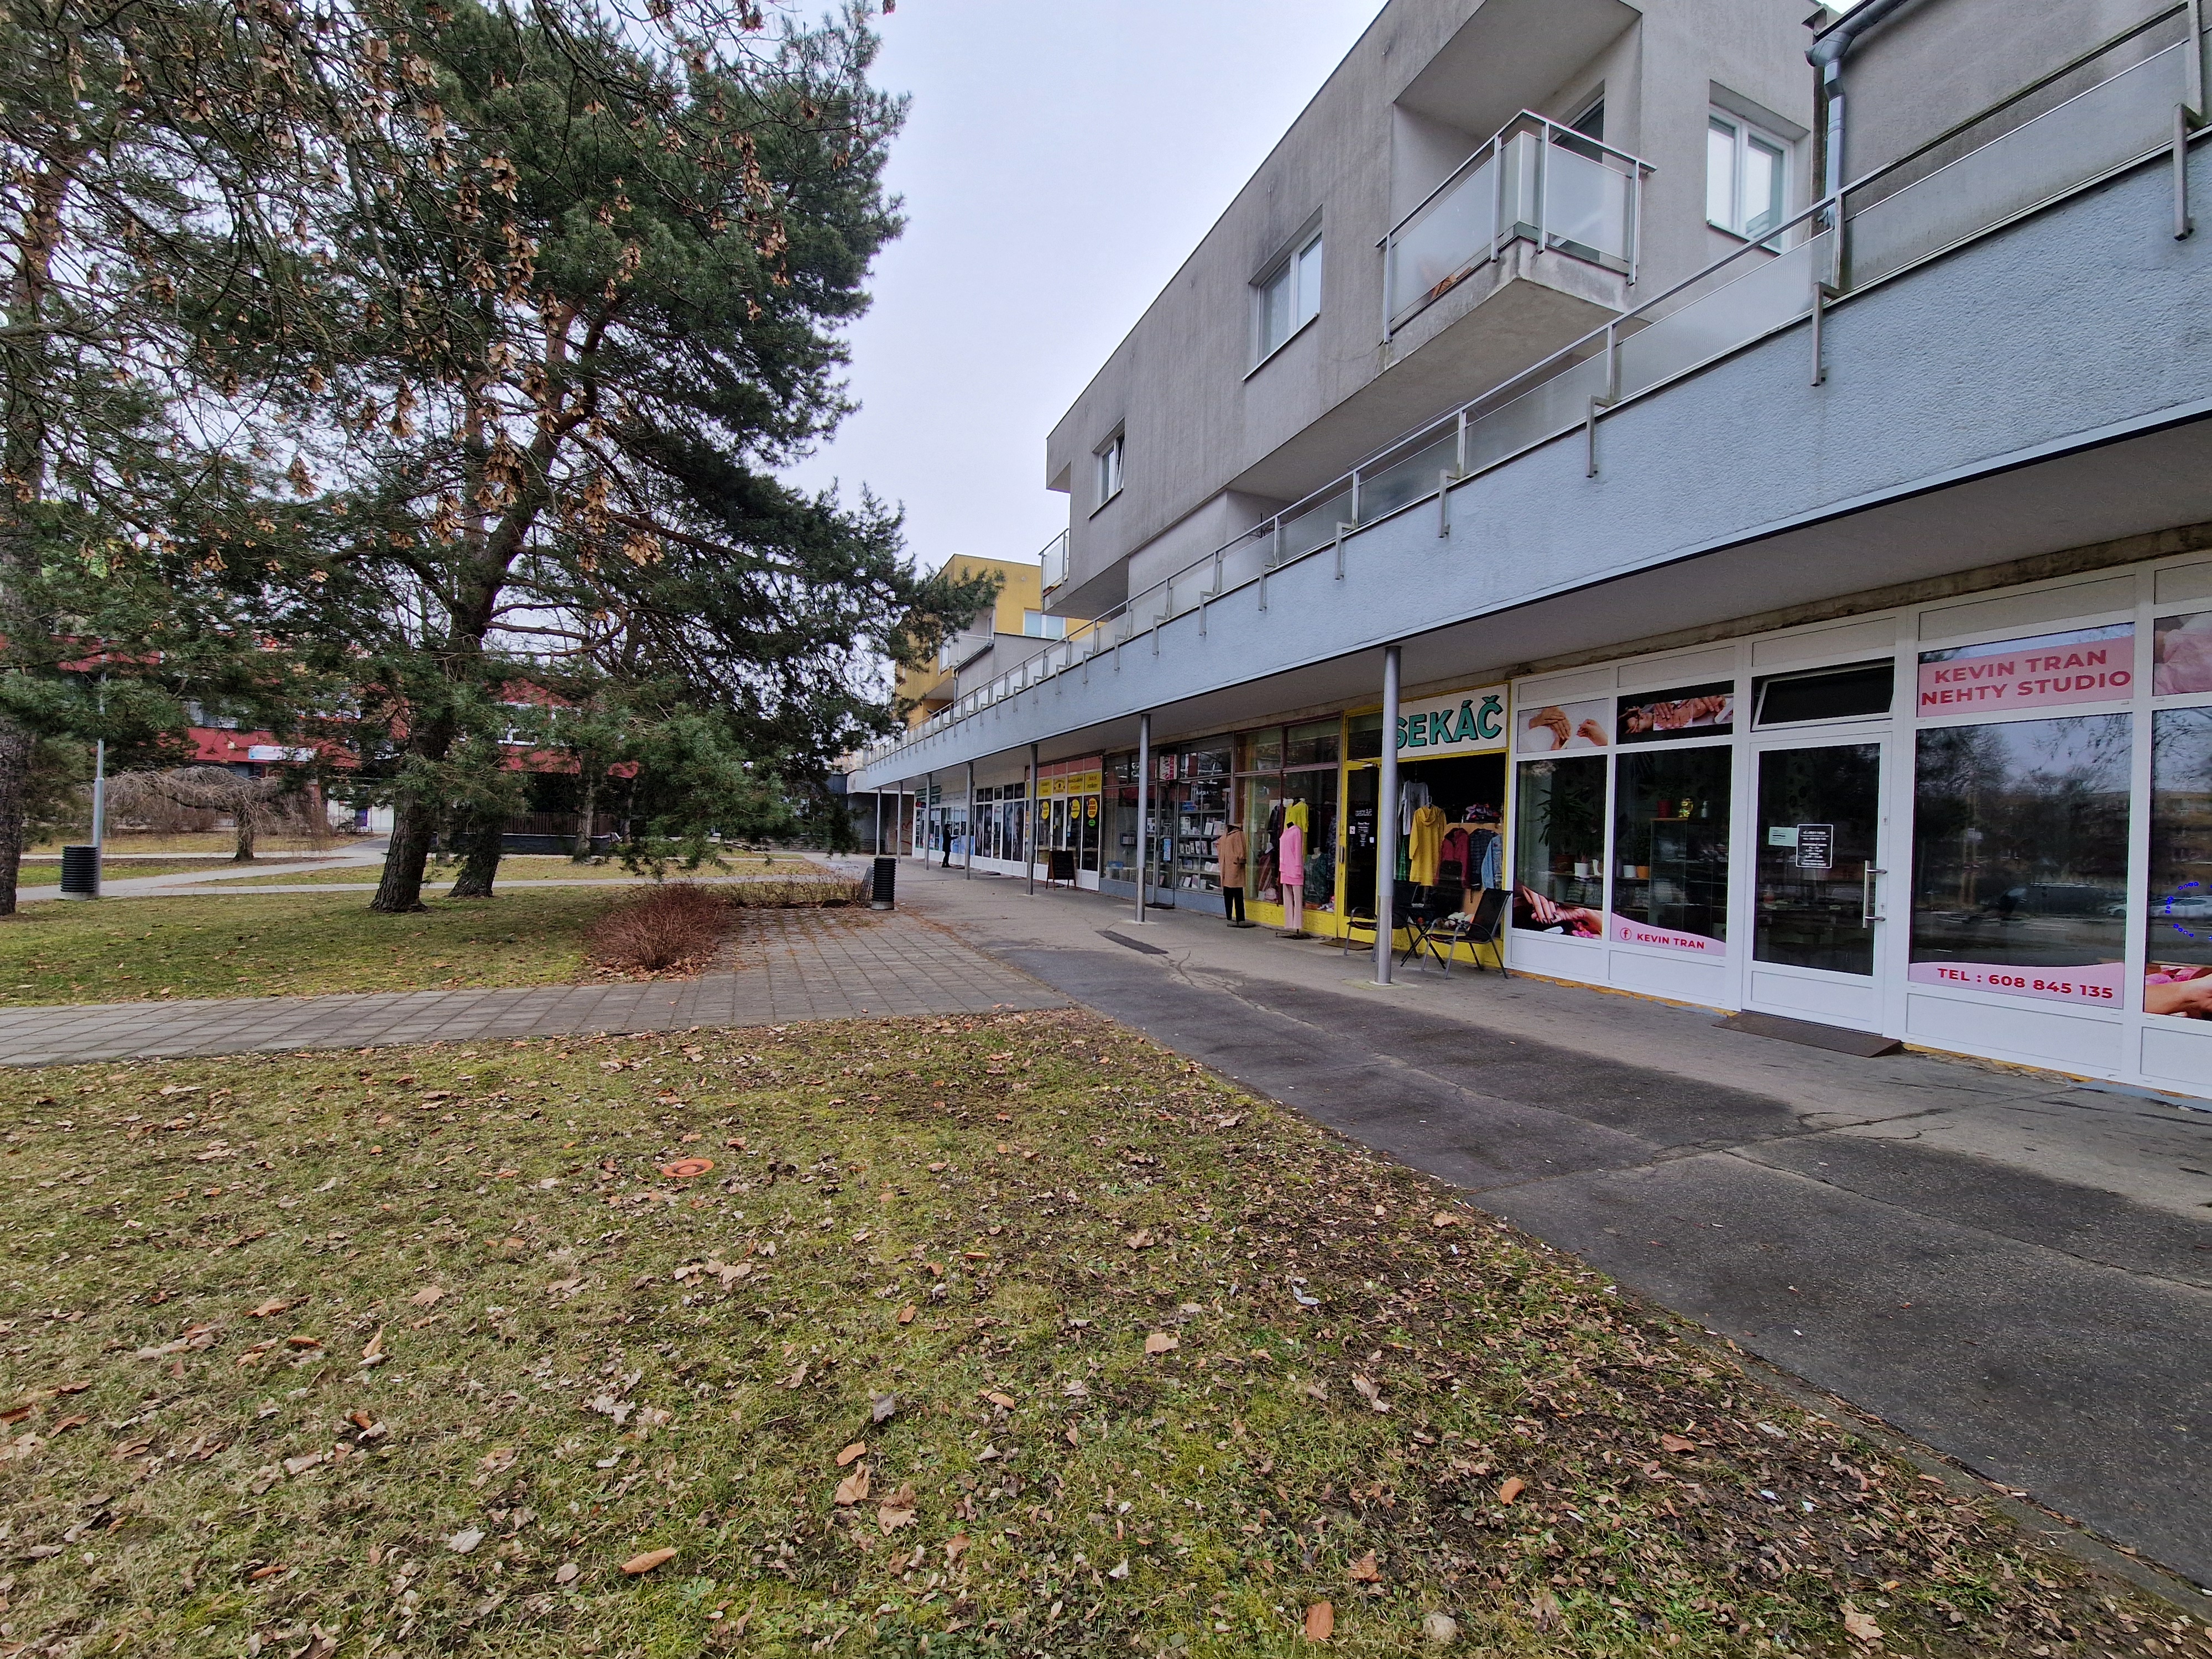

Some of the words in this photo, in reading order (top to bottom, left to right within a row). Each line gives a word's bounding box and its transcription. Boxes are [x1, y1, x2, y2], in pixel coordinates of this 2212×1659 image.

[1934, 661, 2015, 684] KEVIN
[2025, 649, 2106, 673] TRAN
[1921, 684, 2008, 706] NEHTY
[2017, 671, 2131, 696] STUDIO
[1637, 933, 1670, 945] KEVIN
[1673, 938, 1705, 949] TRAN
[1988, 974, 2026, 988] 608
[2033, 979, 2072, 994] 845
[2079, 984, 2113, 999] 135
